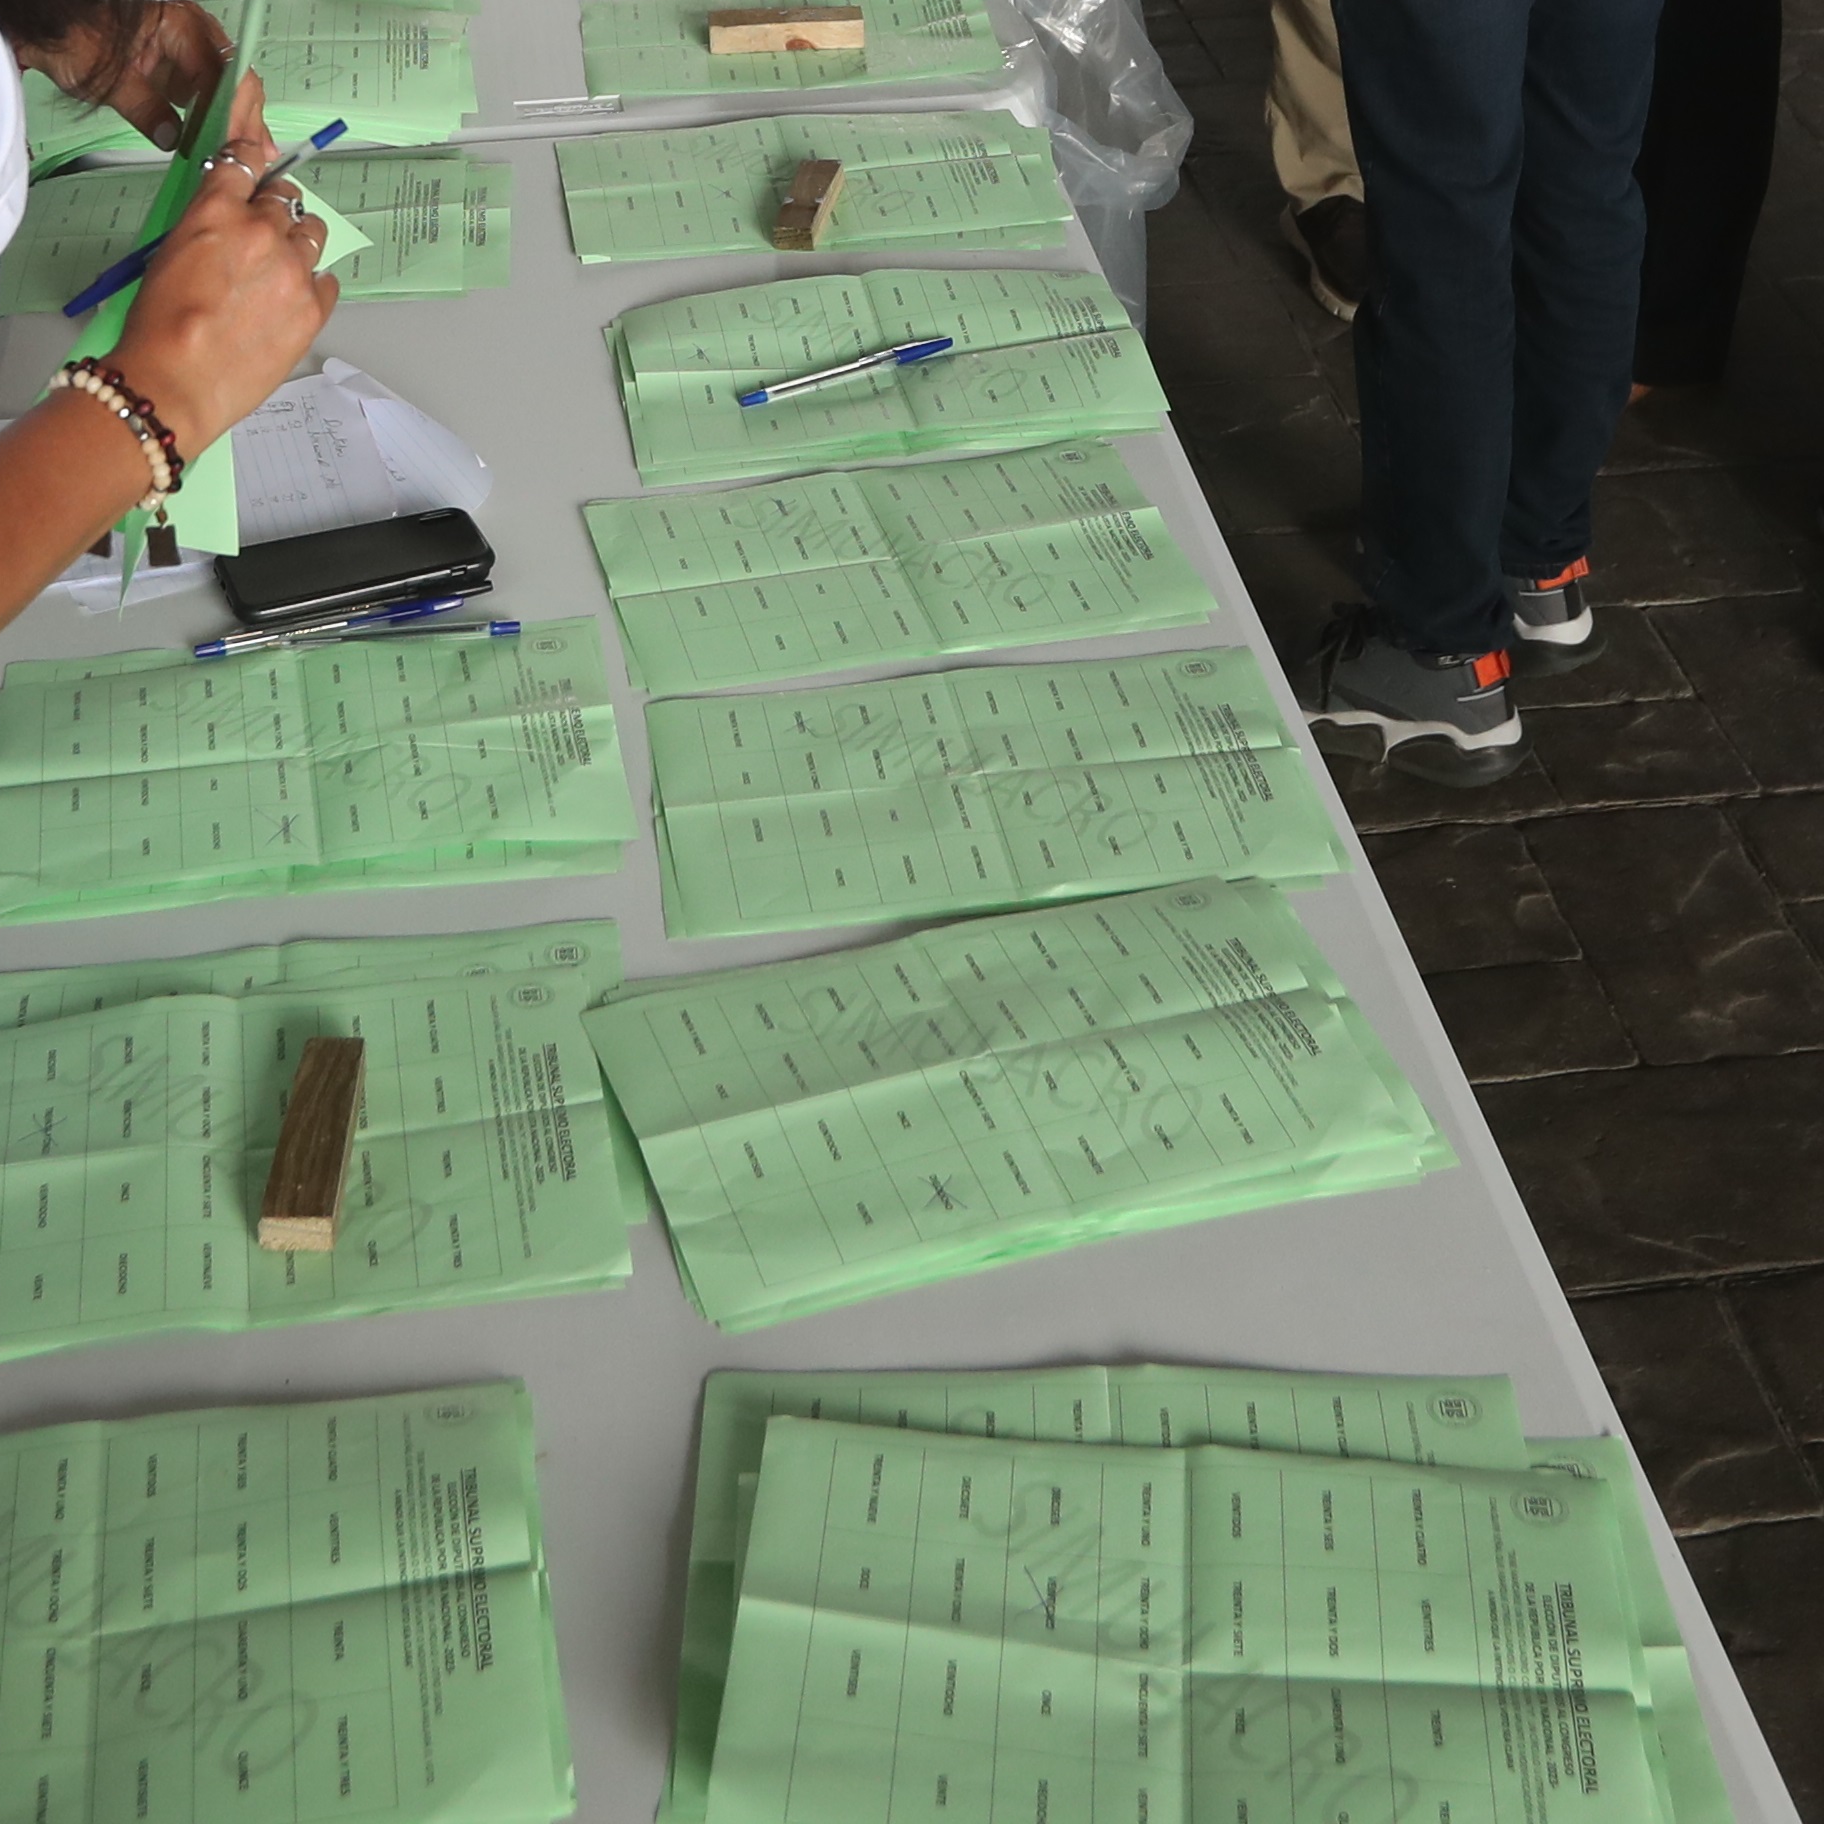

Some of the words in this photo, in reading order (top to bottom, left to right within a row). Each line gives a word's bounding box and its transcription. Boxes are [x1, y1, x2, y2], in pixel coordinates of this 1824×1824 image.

[776, 982, 1203, 1151] SIMULACRO
[460, 1466, 481, 1525] TRIBUNAL
[473, 1592, 495, 1671] ELECTORAL
[1233, 1579, 1242, 1620] TREINTA
[1326, 1585, 1337, 1626] TREINTA
[1233, 1631, 1242, 1657] SIETE
[1328, 1636, 1339, 1658] DOS
[1557, 1581, 1581, 1645] TRIBUNAL
[1574, 1715, 1599, 1795] ELECTORAL
[336, 1714, 349, 1760] TREINTA
[339, 1771, 350, 1798] TRES
